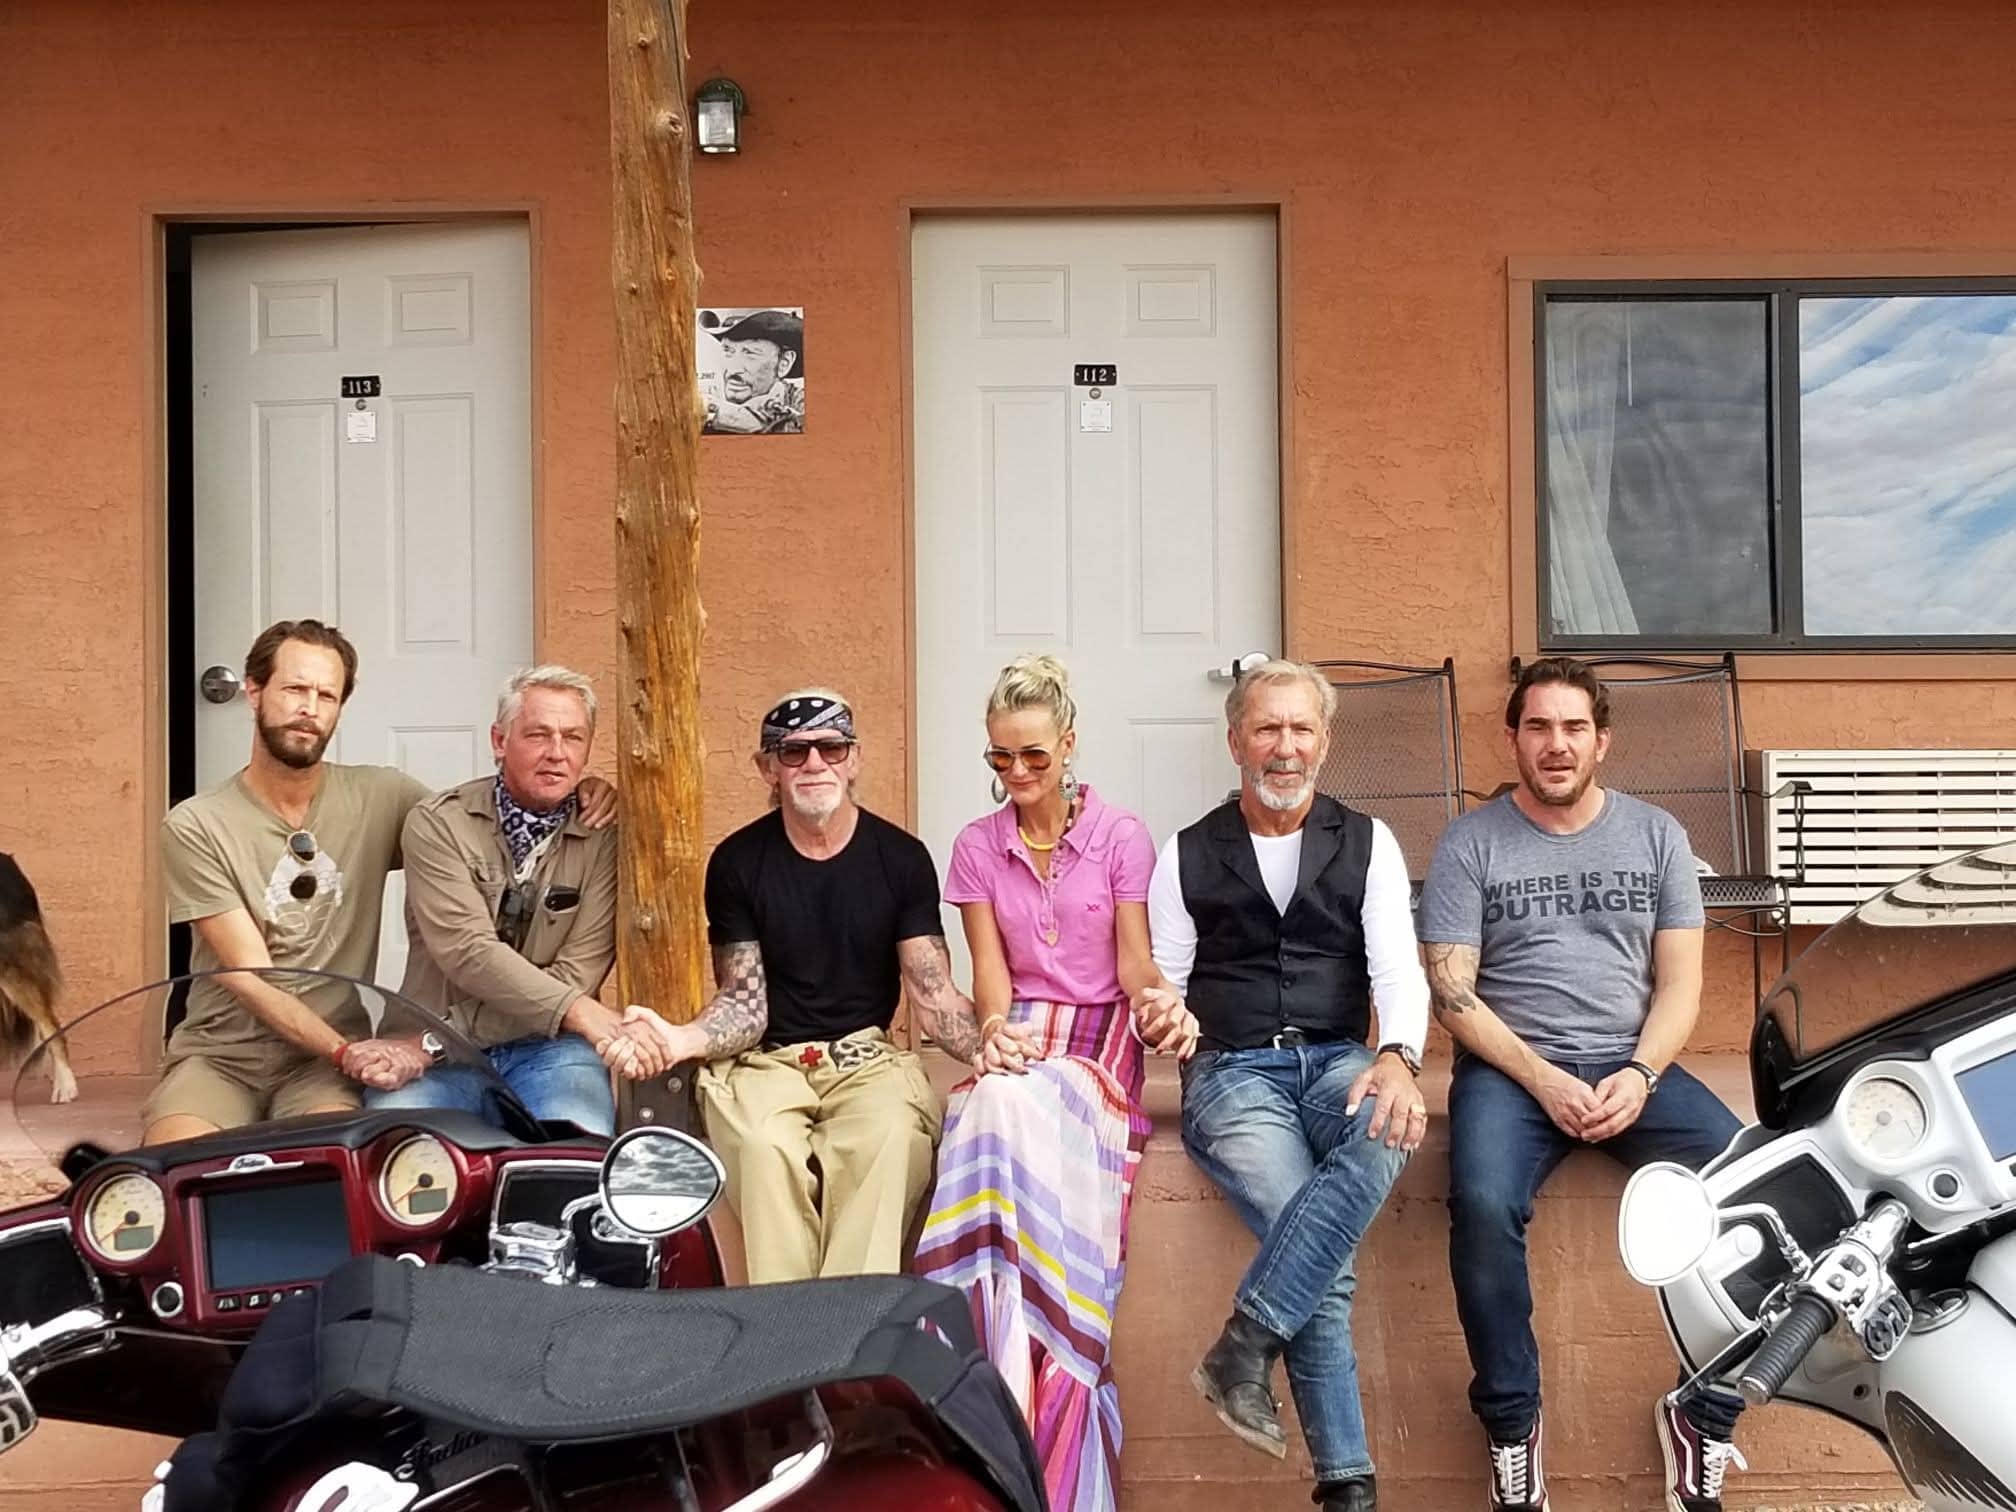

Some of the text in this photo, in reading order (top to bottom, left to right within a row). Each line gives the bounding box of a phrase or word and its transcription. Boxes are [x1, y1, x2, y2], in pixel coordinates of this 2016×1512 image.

[1083, 368, 1107, 382] 112
[349, 380, 372, 394] 113
[1484, 871, 1658, 902] WHERE IS THE
